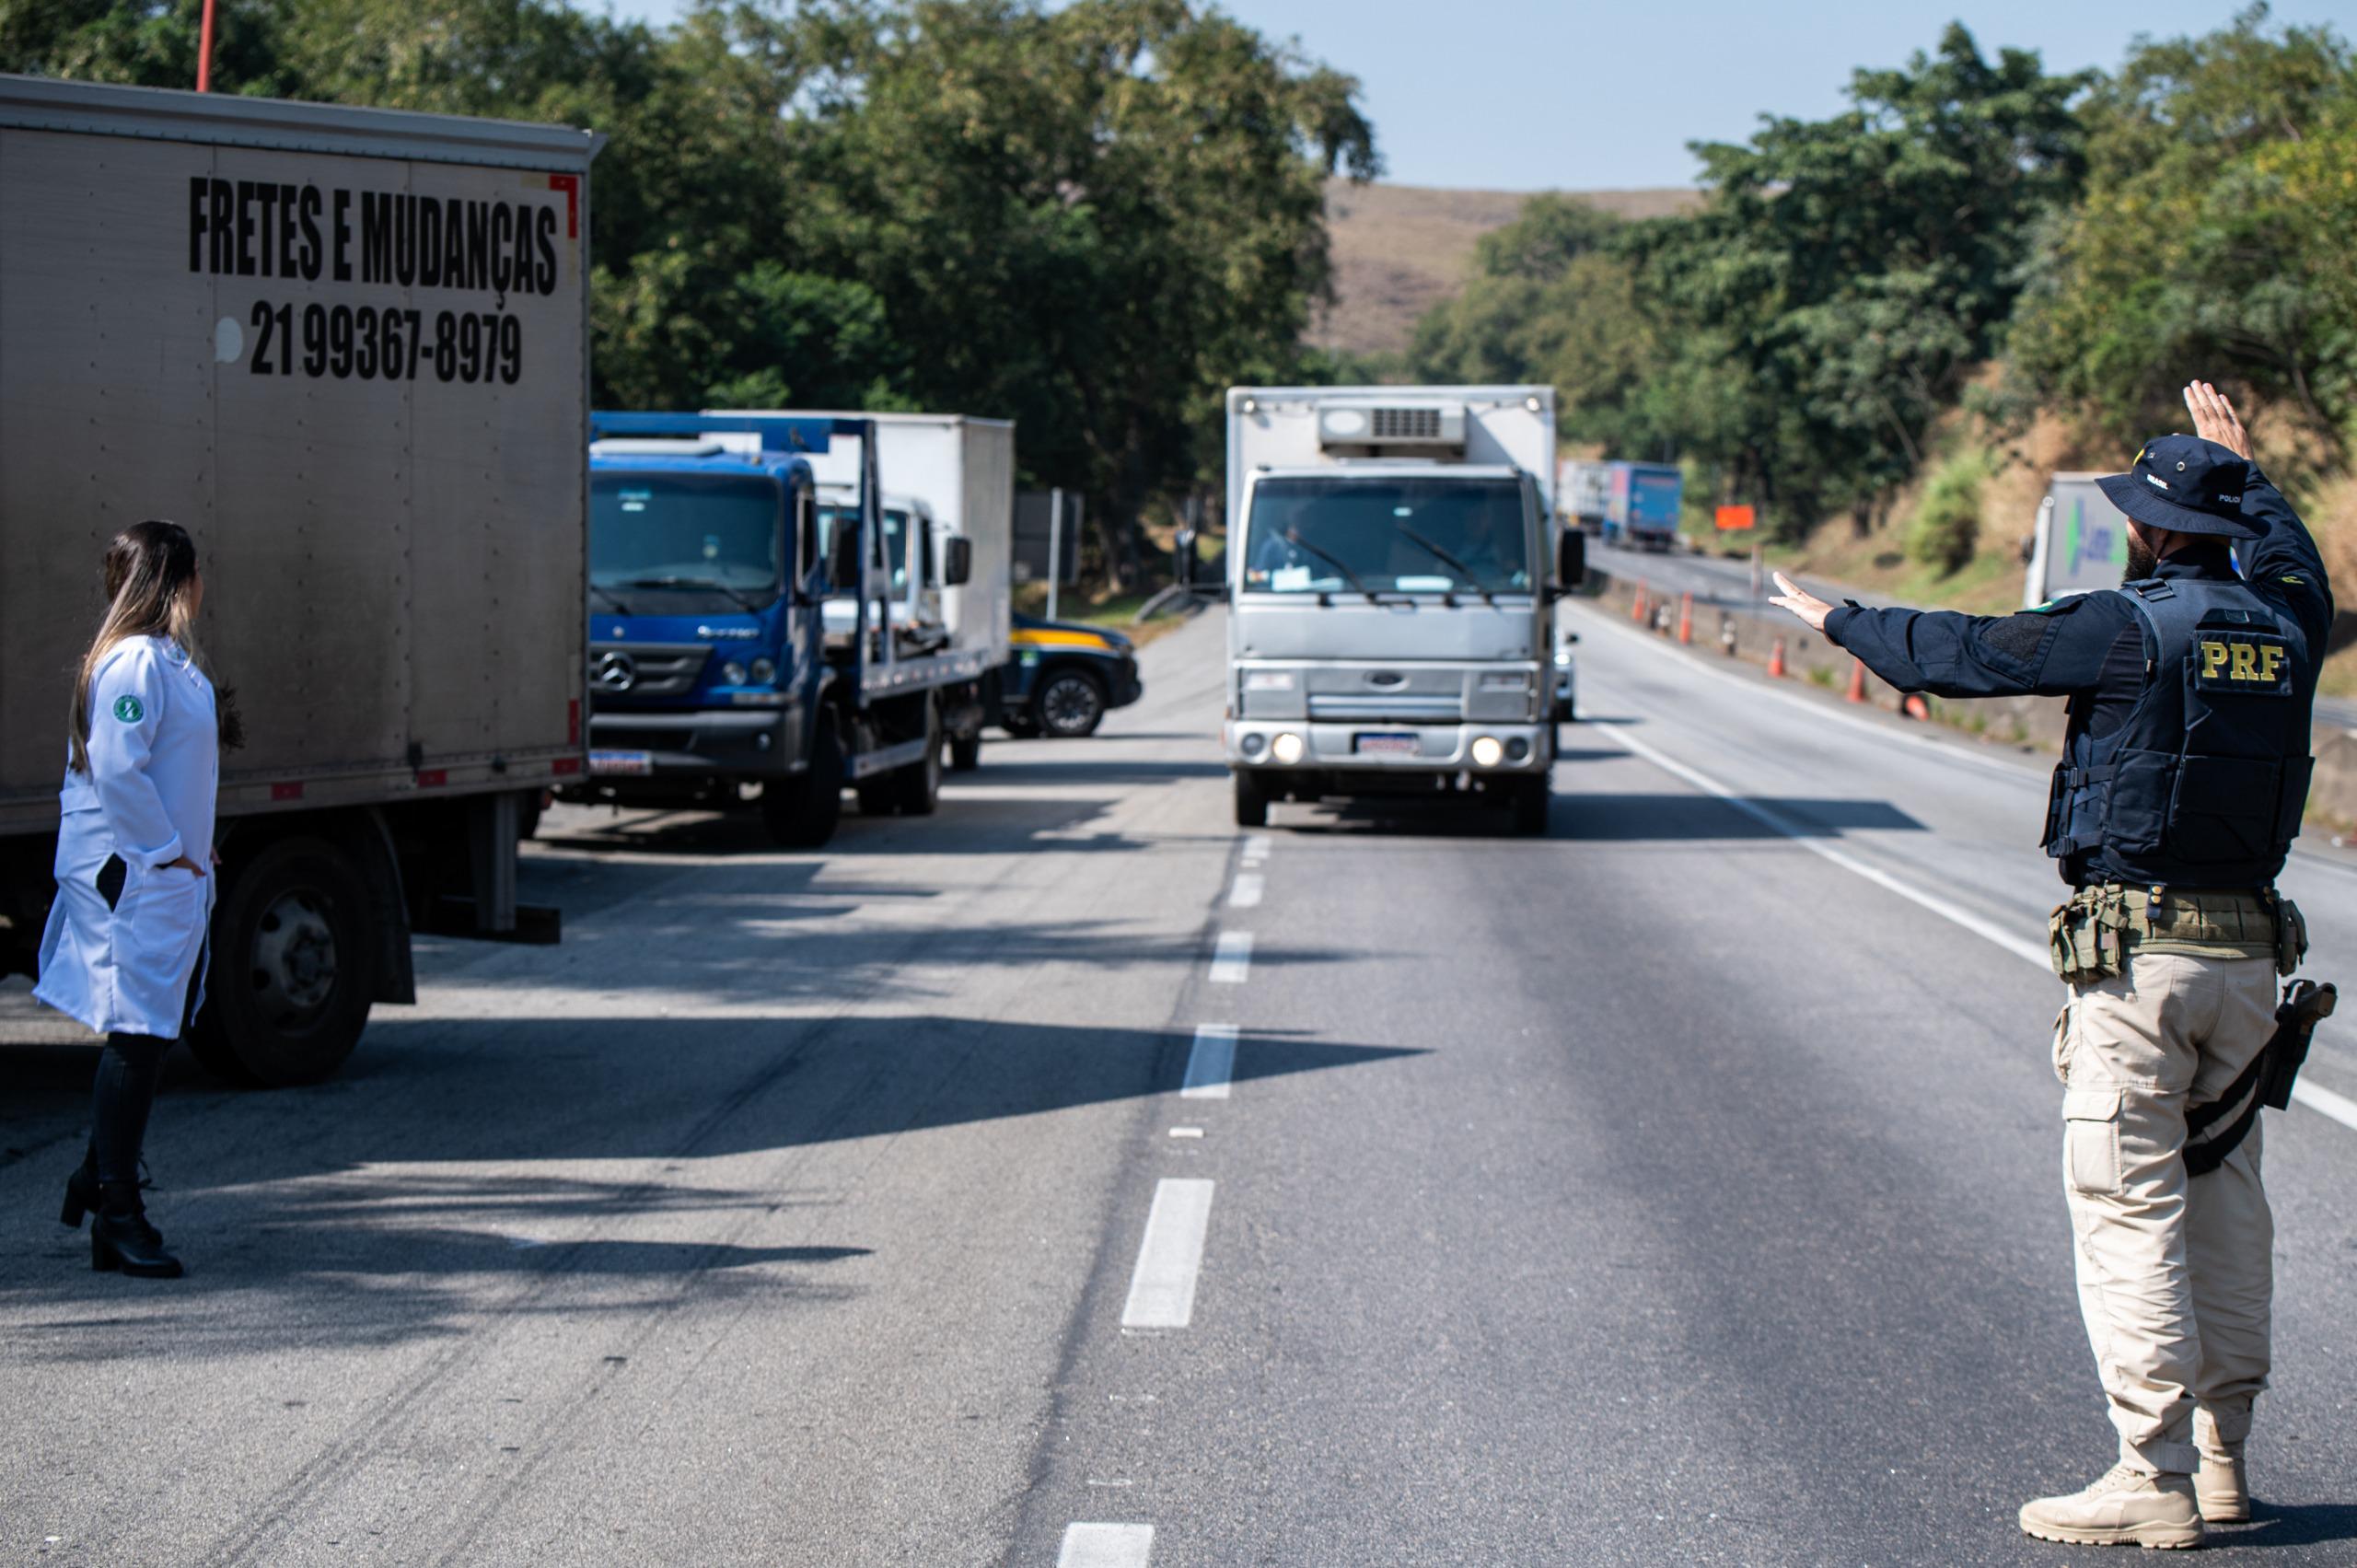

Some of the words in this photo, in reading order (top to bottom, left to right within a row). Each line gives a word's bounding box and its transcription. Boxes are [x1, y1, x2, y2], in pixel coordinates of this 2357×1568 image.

[190, 177, 322, 281] FRETES
[333, 189, 352, 281] E
[361, 191, 556, 310] MUDANÇAS
[250, 300, 293, 376] 21
[303, 303, 521, 385] 99367-8979
[2201, 641, 2283, 681] PRF
